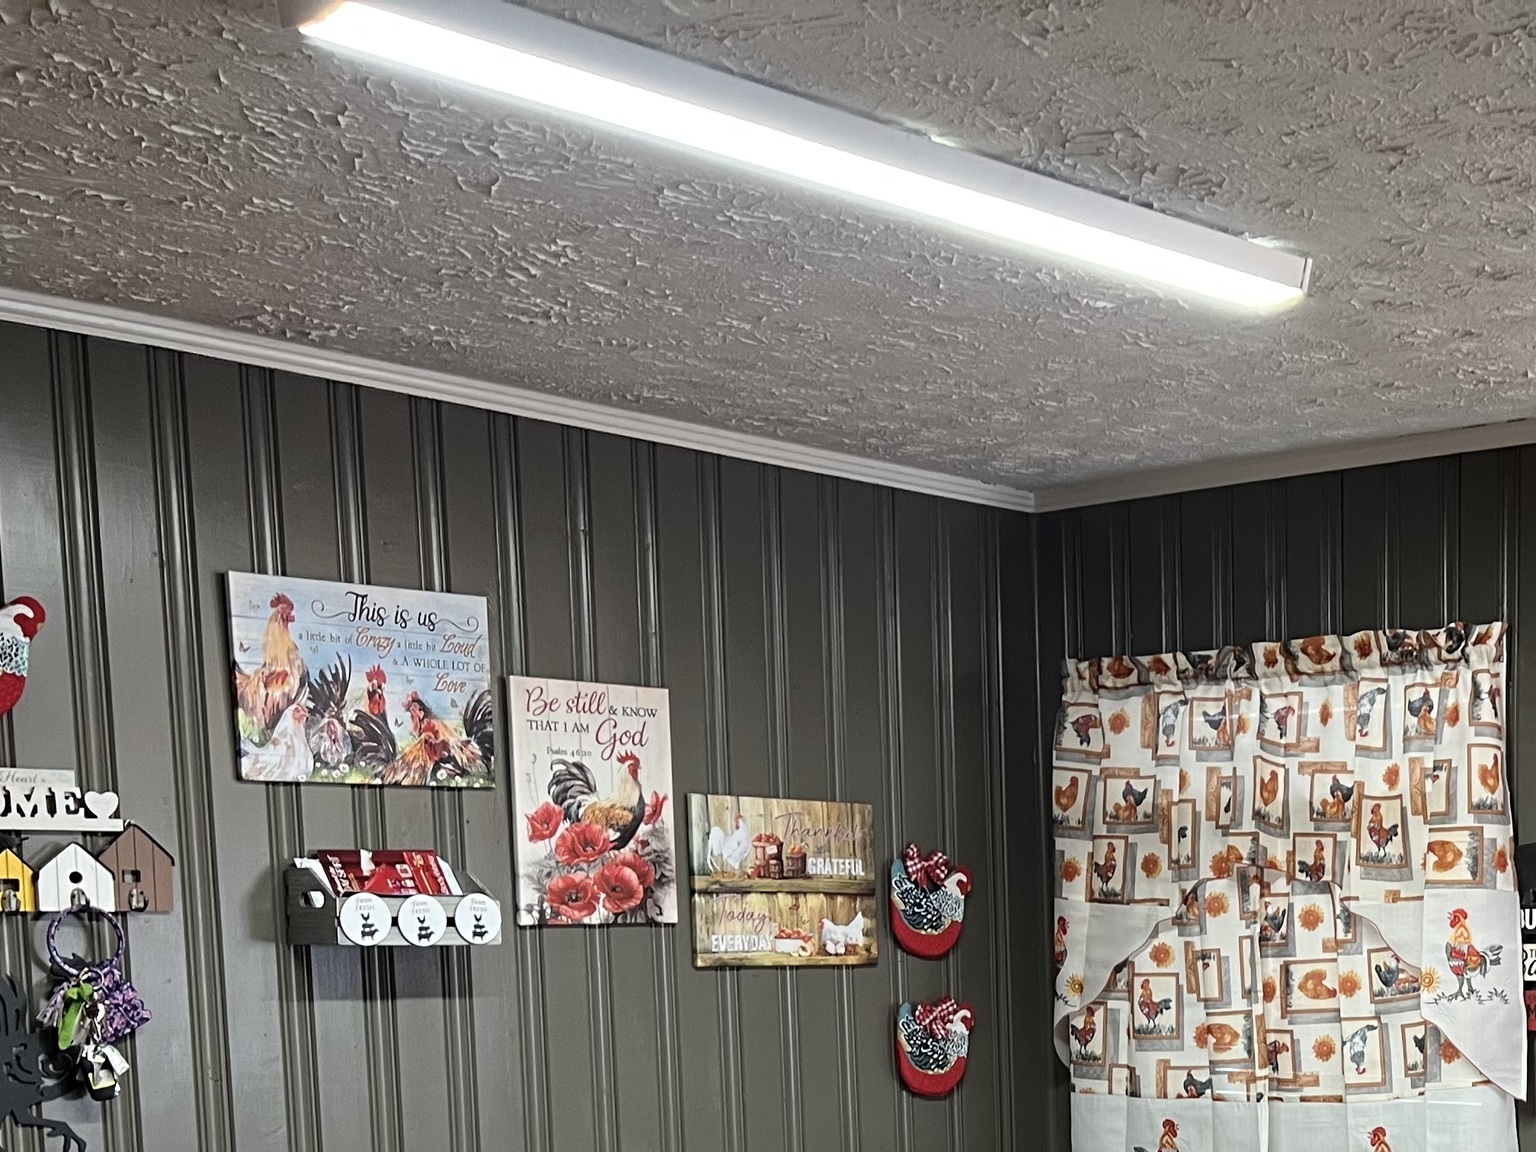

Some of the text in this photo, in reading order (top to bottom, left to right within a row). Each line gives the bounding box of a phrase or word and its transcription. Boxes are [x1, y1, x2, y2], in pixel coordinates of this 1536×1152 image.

[345, 591, 438, 632] This is us
[306, 630, 326, 642] little
[330, 632, 341, 644] bit
[345, 633, 354, 644] of
[356, 627, 397, 659] Crazy
[404, 639, 423, 650] little
[426, 641, 437, 652] bit
[440, 634, 482, 658] Loud
[402, 656, 409, 667] A
[413, 658, 449, 670] WHOLE
[451, 660, 470, 672] LOT
[474, 663, 486, 673] OF
[433, 672, 467, 693] Love
[526, 686, 658, 719] Be still & KNOW
[527, 718, 649, 761] THAT I AM God
[547, 746, 568, 756] Psalm
[0, 770, 38, 784] Heart
[775, 812, 866, 842] Thankful
[807, 857, 865, 876] GRATEFUL
[715, 896, 771, 933] Today
[711, 935, 773, 953] EVERYDAY
